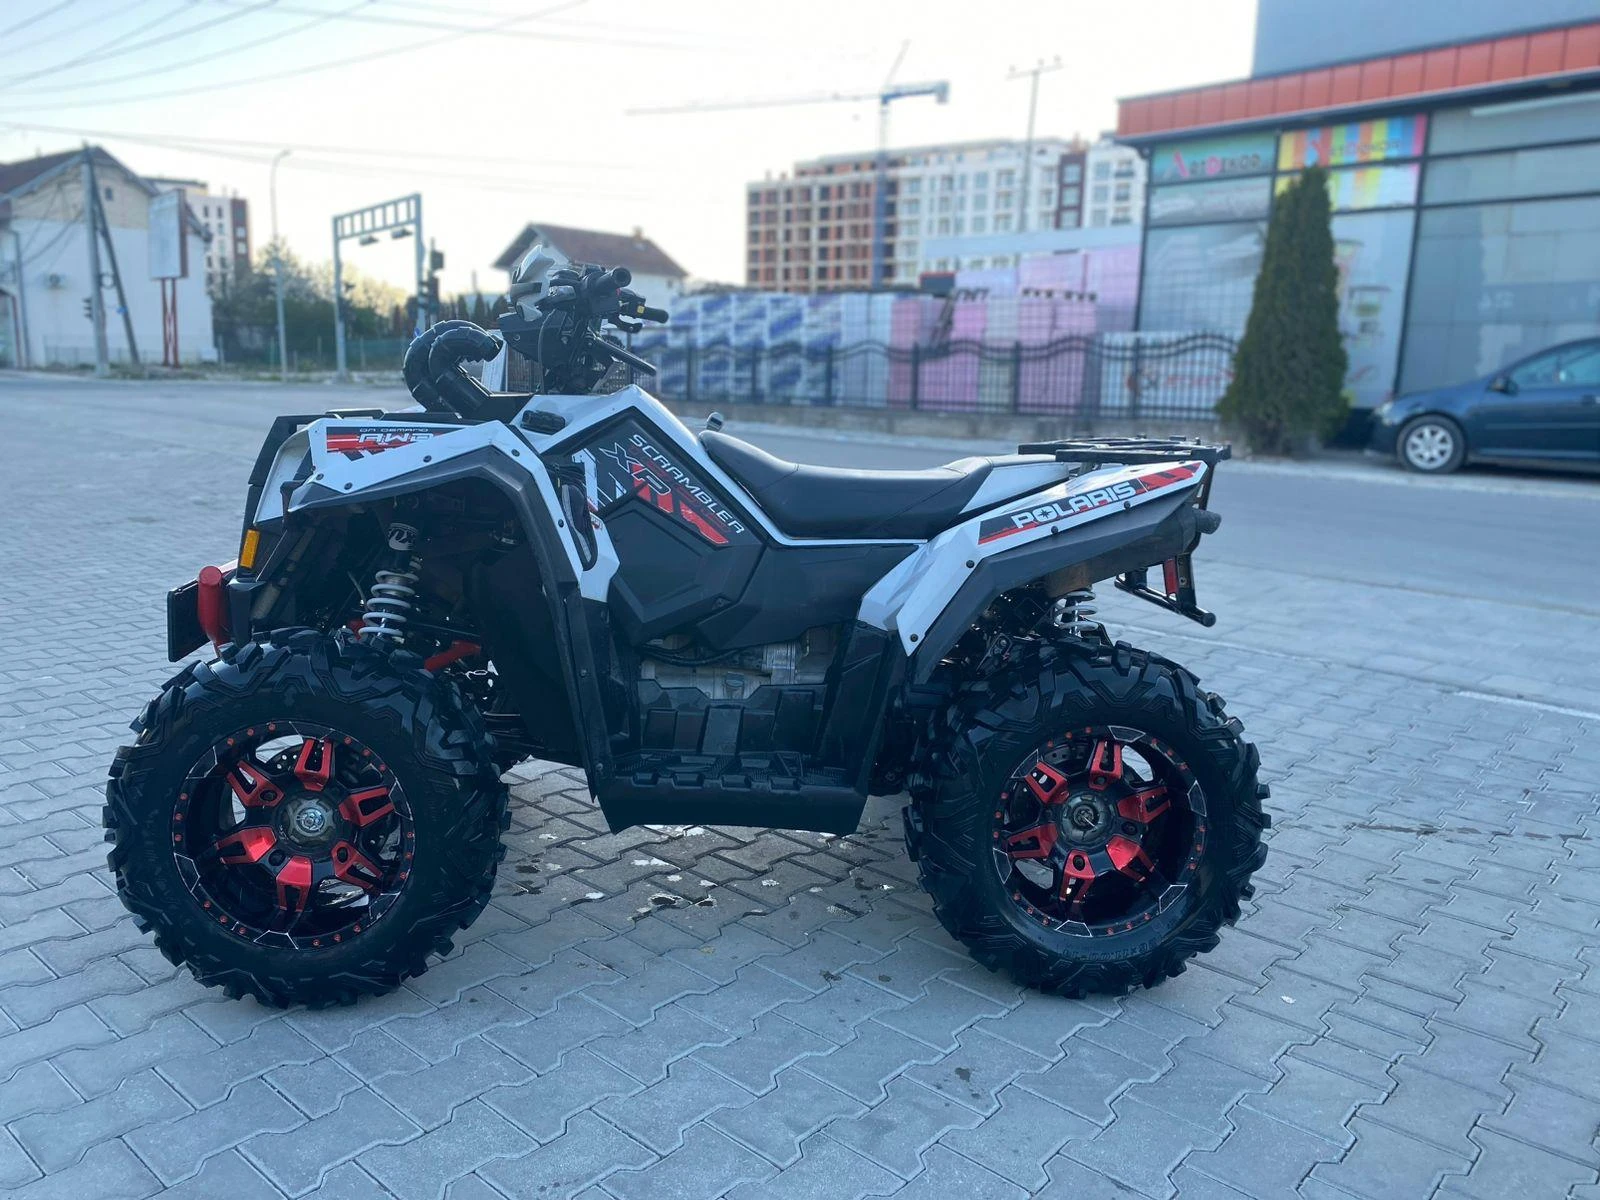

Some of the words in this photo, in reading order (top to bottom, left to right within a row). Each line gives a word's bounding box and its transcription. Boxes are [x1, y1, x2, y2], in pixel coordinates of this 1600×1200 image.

[359, 432, 434, 443] AWD
[598, 442, 672, 496] XP
[628, 434, 745, 534] SCRAMBLER
[1011, 481, 1137, 529] POLARIS
